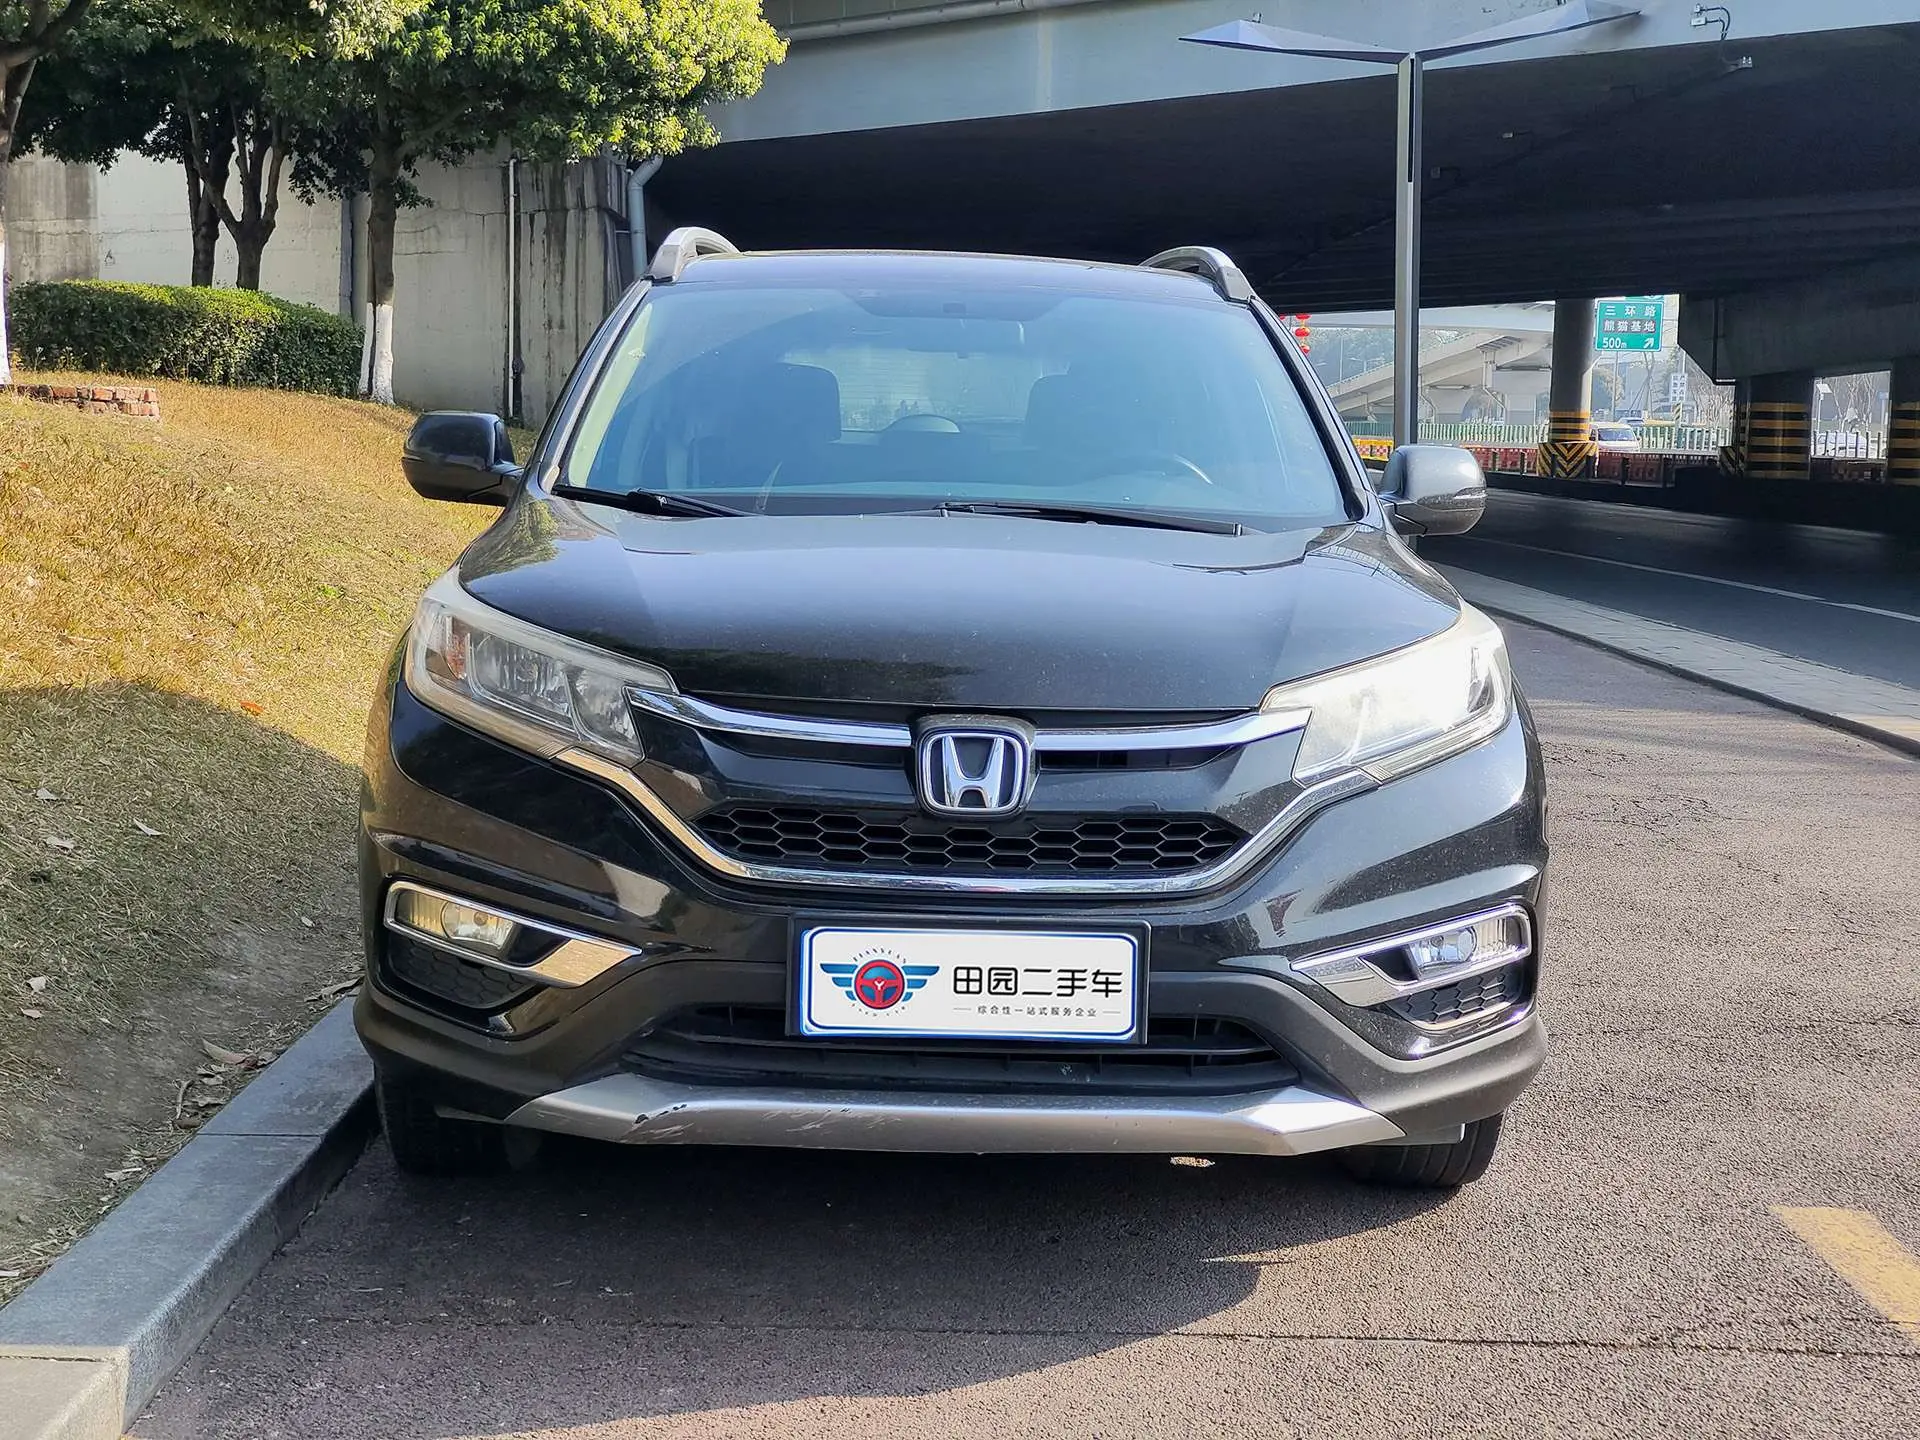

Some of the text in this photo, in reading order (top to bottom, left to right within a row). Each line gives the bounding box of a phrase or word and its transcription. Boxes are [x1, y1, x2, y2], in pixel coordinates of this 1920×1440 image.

[1604, 305, 1657, 317] 三环路
[1604, 320, 1655, 332] 熊猫基地
[1602, 337, 1627, 349] 500m
[953, 966, 1123, 999] 田园二手车
[977, 1005, 1097, 1017] 综合性一站式服务企业
